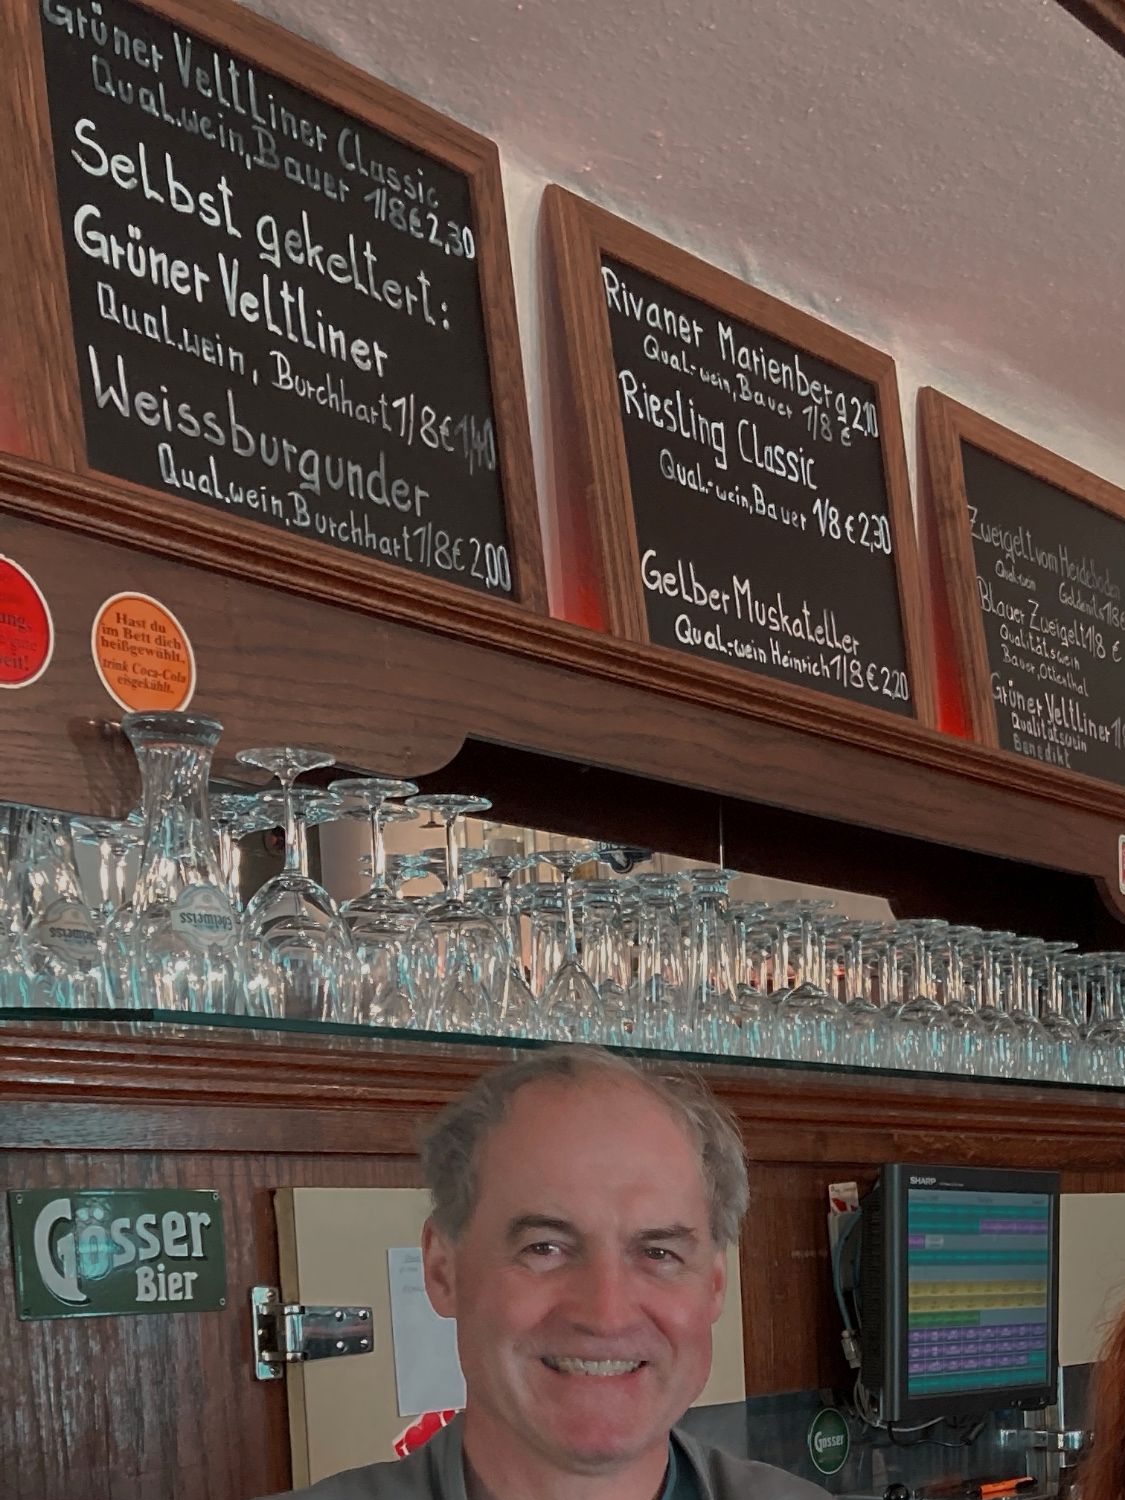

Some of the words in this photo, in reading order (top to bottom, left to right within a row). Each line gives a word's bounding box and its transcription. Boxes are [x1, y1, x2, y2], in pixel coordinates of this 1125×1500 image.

[43, 0, 163, 74] Grüner
[173, 32, 327, 152] Veltliner
[337, 127, 439, 208] Classic
[71, 118, 242, 239] Selbst
[256, 209, 450, 331] gekeltert:
[73, 204, 211, 303] Grüner
[217, 252, 388, 377] Veltliner
[601, 266, 703, 347] Rivaner
[717, 320, 847, 424] Marienberg
[270, 350, 392, 433] Burchhart
[88, 344, 430, 517] Weissburgunder
[618, 369, 729, 471] Riesling
[737, 418, 818, 490] Classic
[287, 490, 413, 562] Burchhart
[966, 504, 1036, 564] Zweigelt
[102, 623, 119, 638] im
[123, 627, 151, 644] Bett
[154, 634, 182, 650] dich
[115, 611, 147, 630] Hast
[150, 619, 167, 634] du
[641, 549, 730, 615] Gelber
[732, 574, 860, 656] Muskateller
[976, 575, 1026, 625] Blauer
[1027, 598, 1087, 649] Zweigelt
[102, 657, 129, 672] trink
[131, 661, 187, 684] Coca-Cola
[769, 637, 831, 679] Heinrich
[990, 671, 1043, 717] Grüner
[1044, 692, 1111, 743] Veltliner
[910, 1176, 937, 1186] SHARP
[34, 1198, 211, 1302] Gösser
[135, 1262, 198, 1302] Bier
